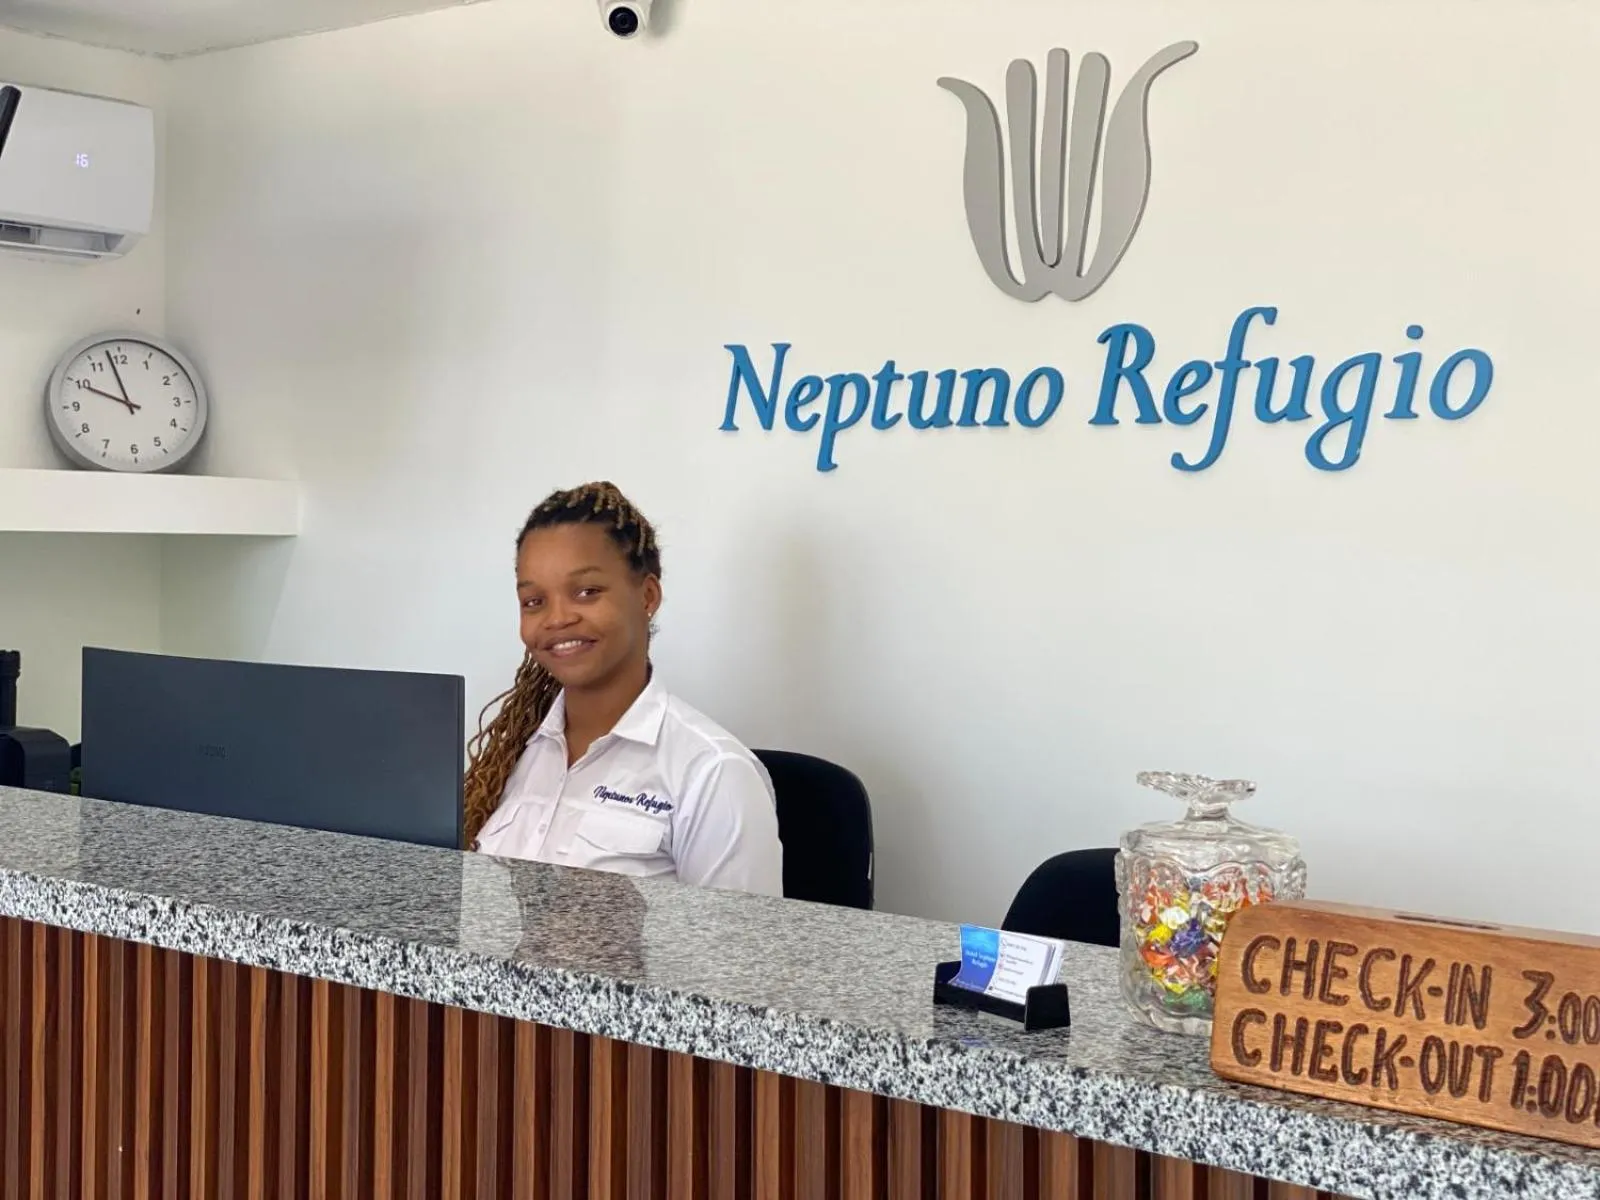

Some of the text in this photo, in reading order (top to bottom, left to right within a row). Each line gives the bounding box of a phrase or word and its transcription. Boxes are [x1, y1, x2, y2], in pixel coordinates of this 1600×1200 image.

[75, 154, 88, 168] 16
[113, 355, 128, 365] 12
[143, 360, 149, 370] 1
[90, 362, 104, 372] 11
[75, 378, 91, 390] 10
[162, 375, 171, 386] 2
[719, 307, 1495, 472] Neptuno Refugio
[72, 401, 81, 411] 9
[172, 397, 181, 407] 3
[81, 423, 90, 434] 8
[169, 418, 178, 428] 4
[102, 439, 110, 449] 7
[153, 436, 162, 447] 5
[130, 444, 139, 455] 6
[636, 792, 674, 814] Refugio
[1241, 934, 1600, 1045] CHECK-IN 3:00
[1231, 1008, 1600, 1131] CHECK-OUT 1:00
